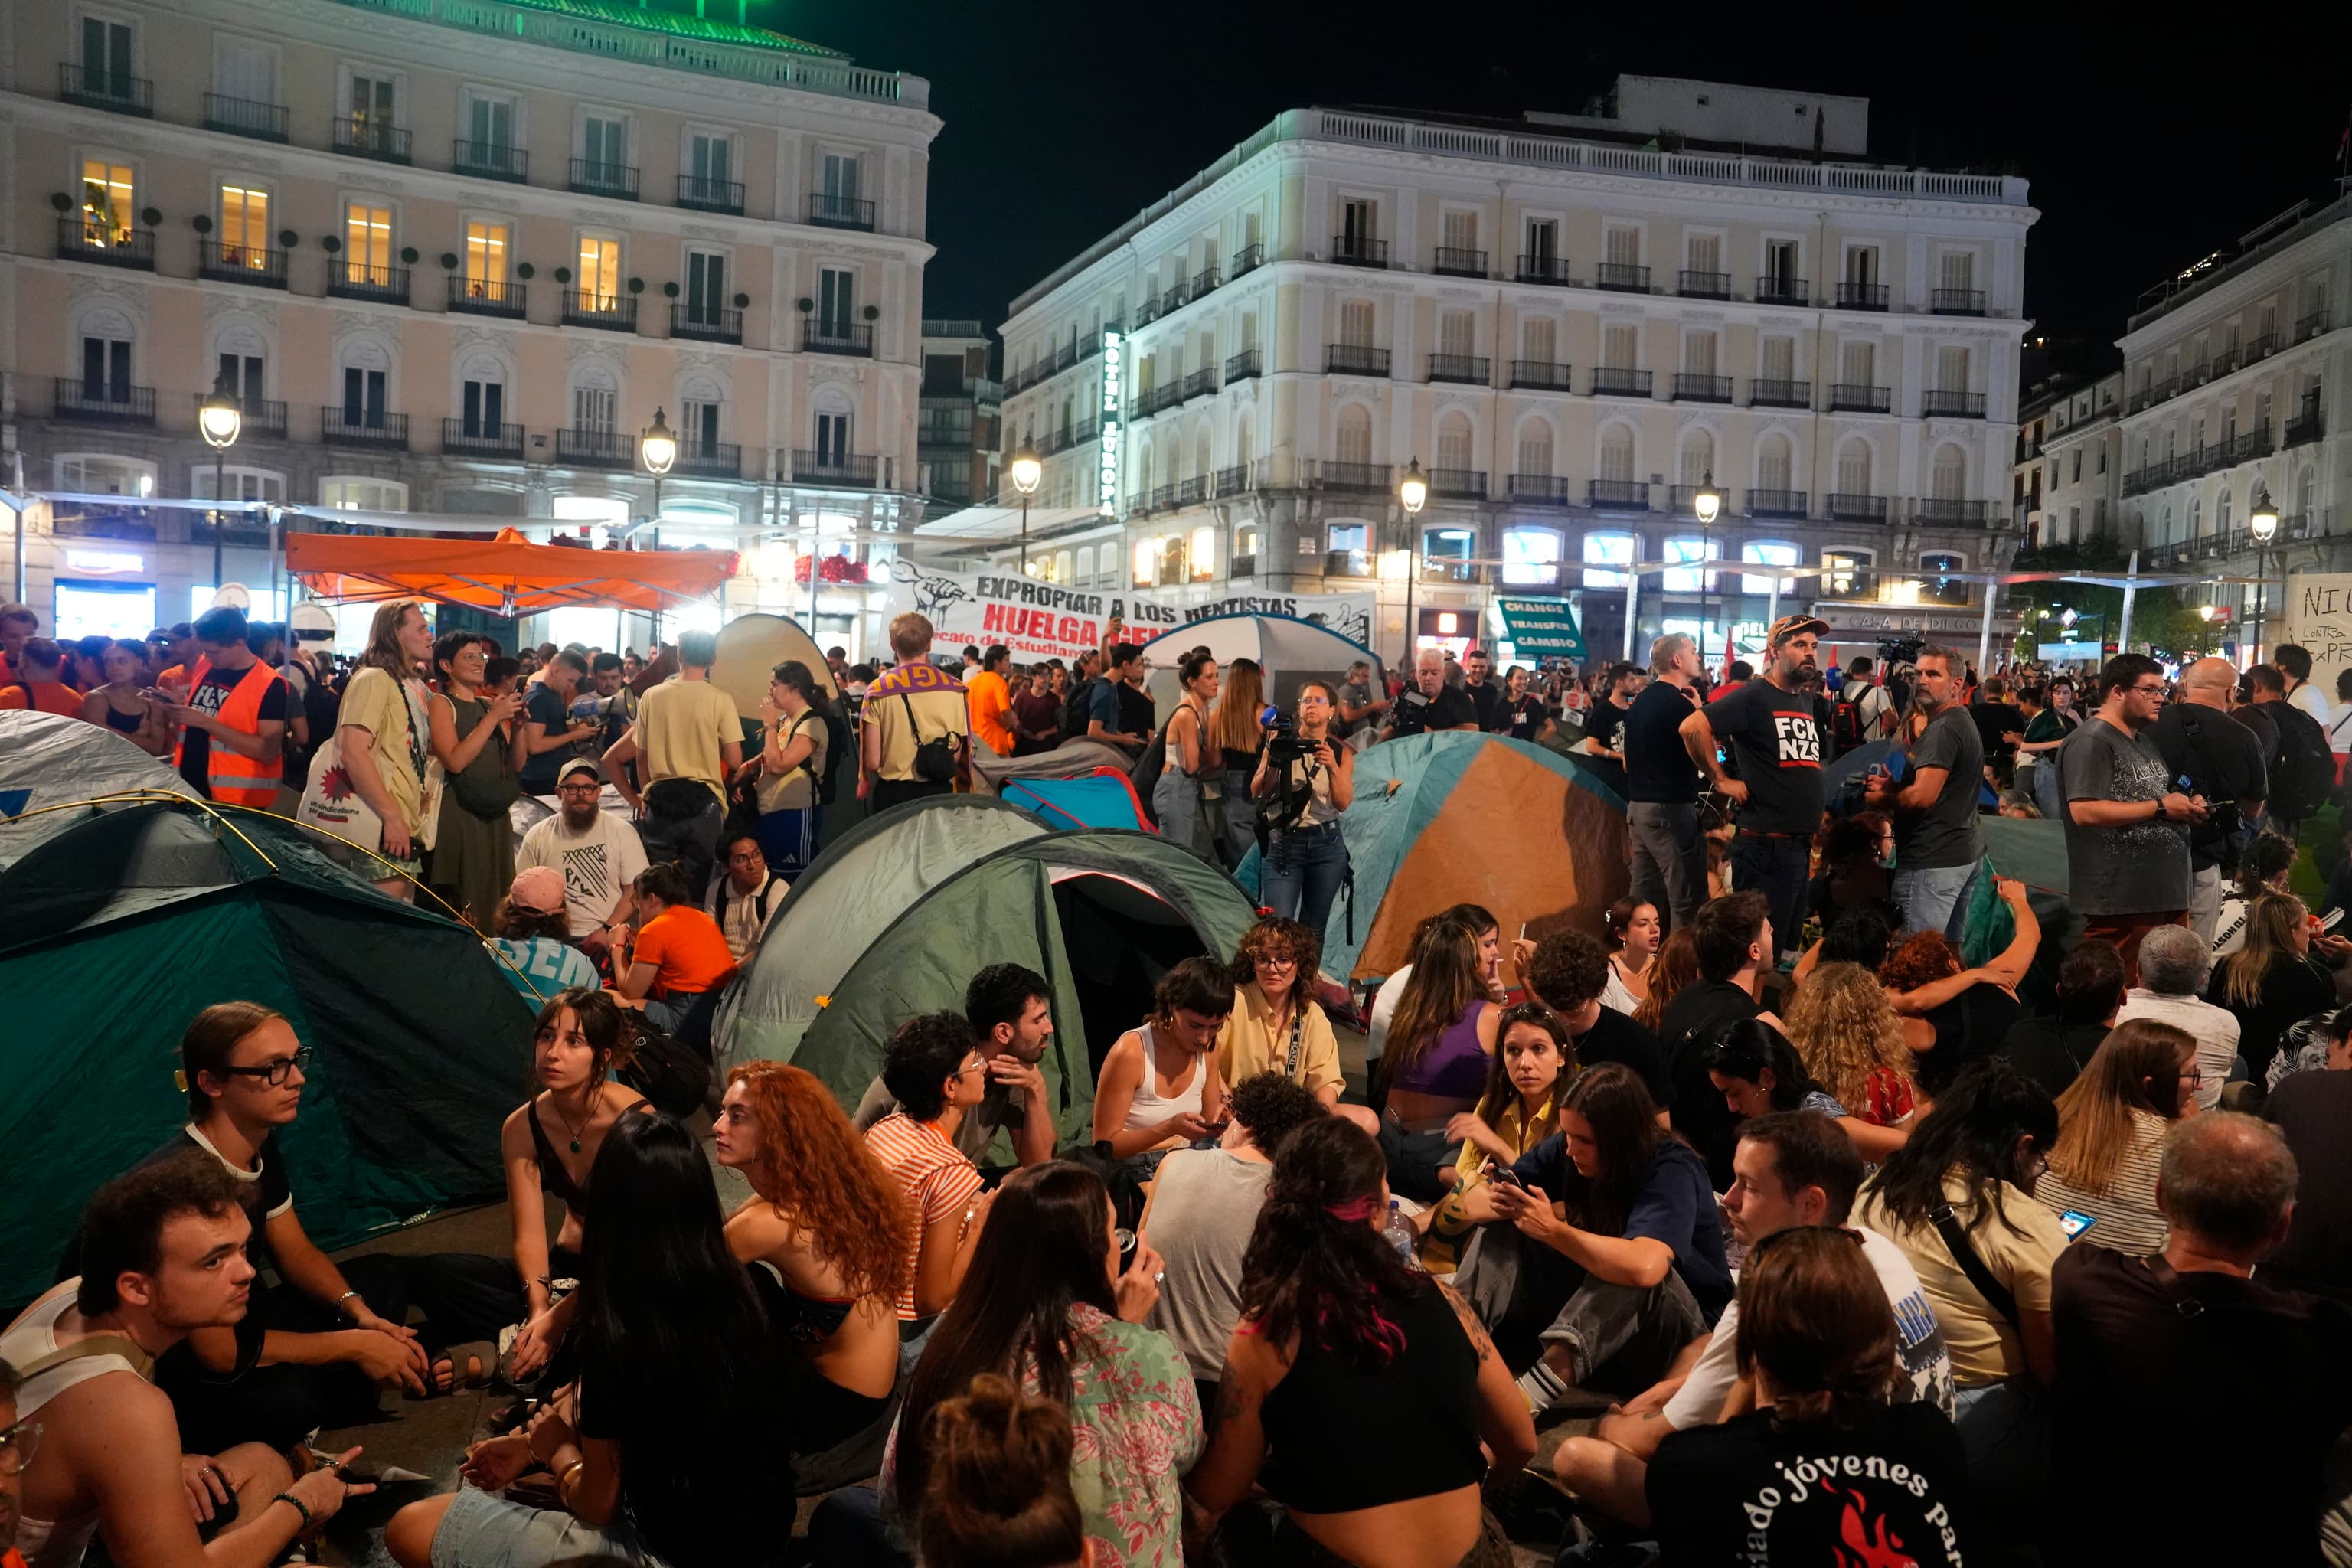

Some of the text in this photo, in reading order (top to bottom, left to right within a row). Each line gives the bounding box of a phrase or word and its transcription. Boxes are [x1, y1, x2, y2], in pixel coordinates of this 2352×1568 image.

[1099, 332, 1120, 516] HOTEL EUROPA
[976, 576, 1102, 616] EXPROPIAR
[1110, 599, 1125, 619] A
[1134, 602, 1176, 623] LOS
[1504, 602, 1565, 614] CHANGE
[983, 603, 1098, 647] HUELGA
[1510, 620, 1571, 631] TRANSFER
[1517, 637, 1577, 648] CAMBIO
[1775, 717, 1820, 742] FCK
[1779, 738, 1820, 763] NZS
[1775, 1455, 1929, 1503] jóvenes
